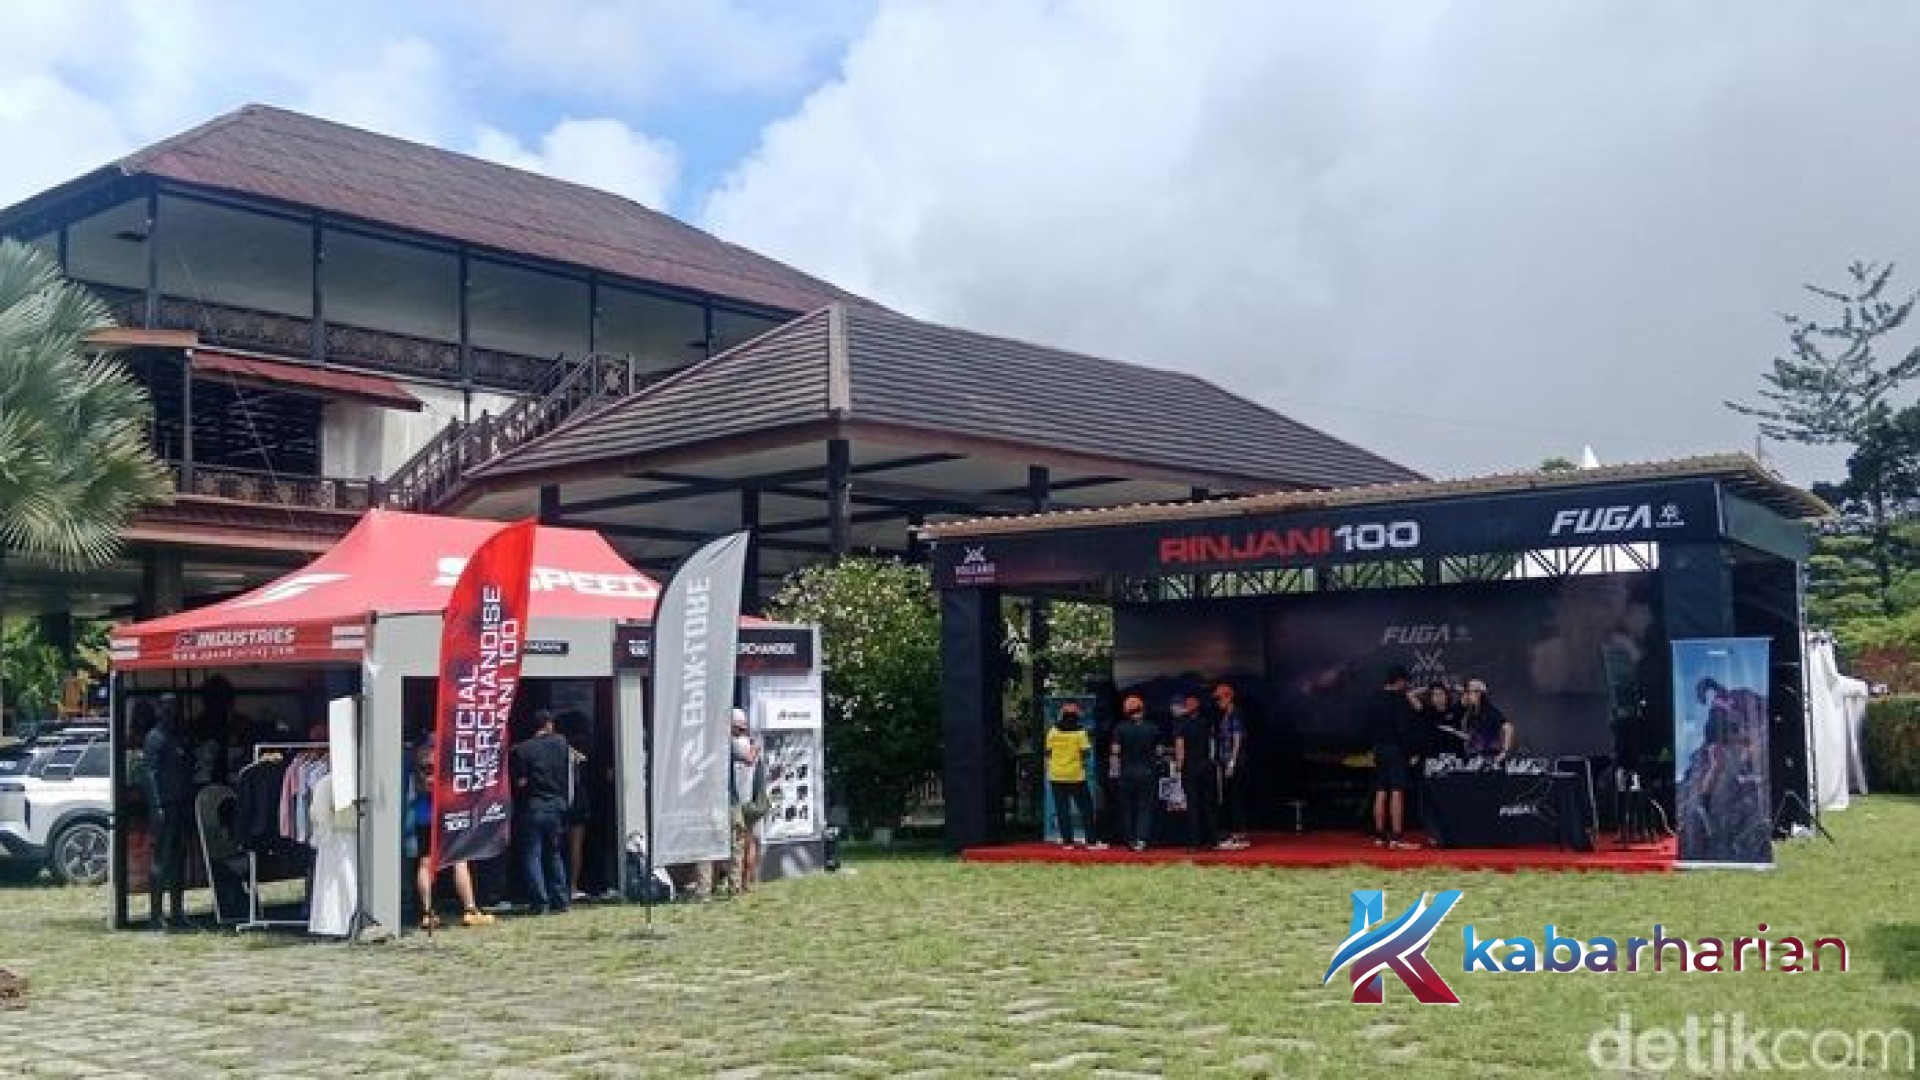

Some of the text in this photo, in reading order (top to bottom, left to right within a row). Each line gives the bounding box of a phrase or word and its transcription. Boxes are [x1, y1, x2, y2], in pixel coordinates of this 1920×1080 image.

[1549, 504, 1651, 535] FUGA
[1159, 521, 1421, 565] RINJANI 100
[500, 620, 519, 667] 100
[1382, 623, 1449, 645] FUGA
[472, 585, 501, 792] MERCHANDISE
[453, 664, 479, 793] OFFICIAL
